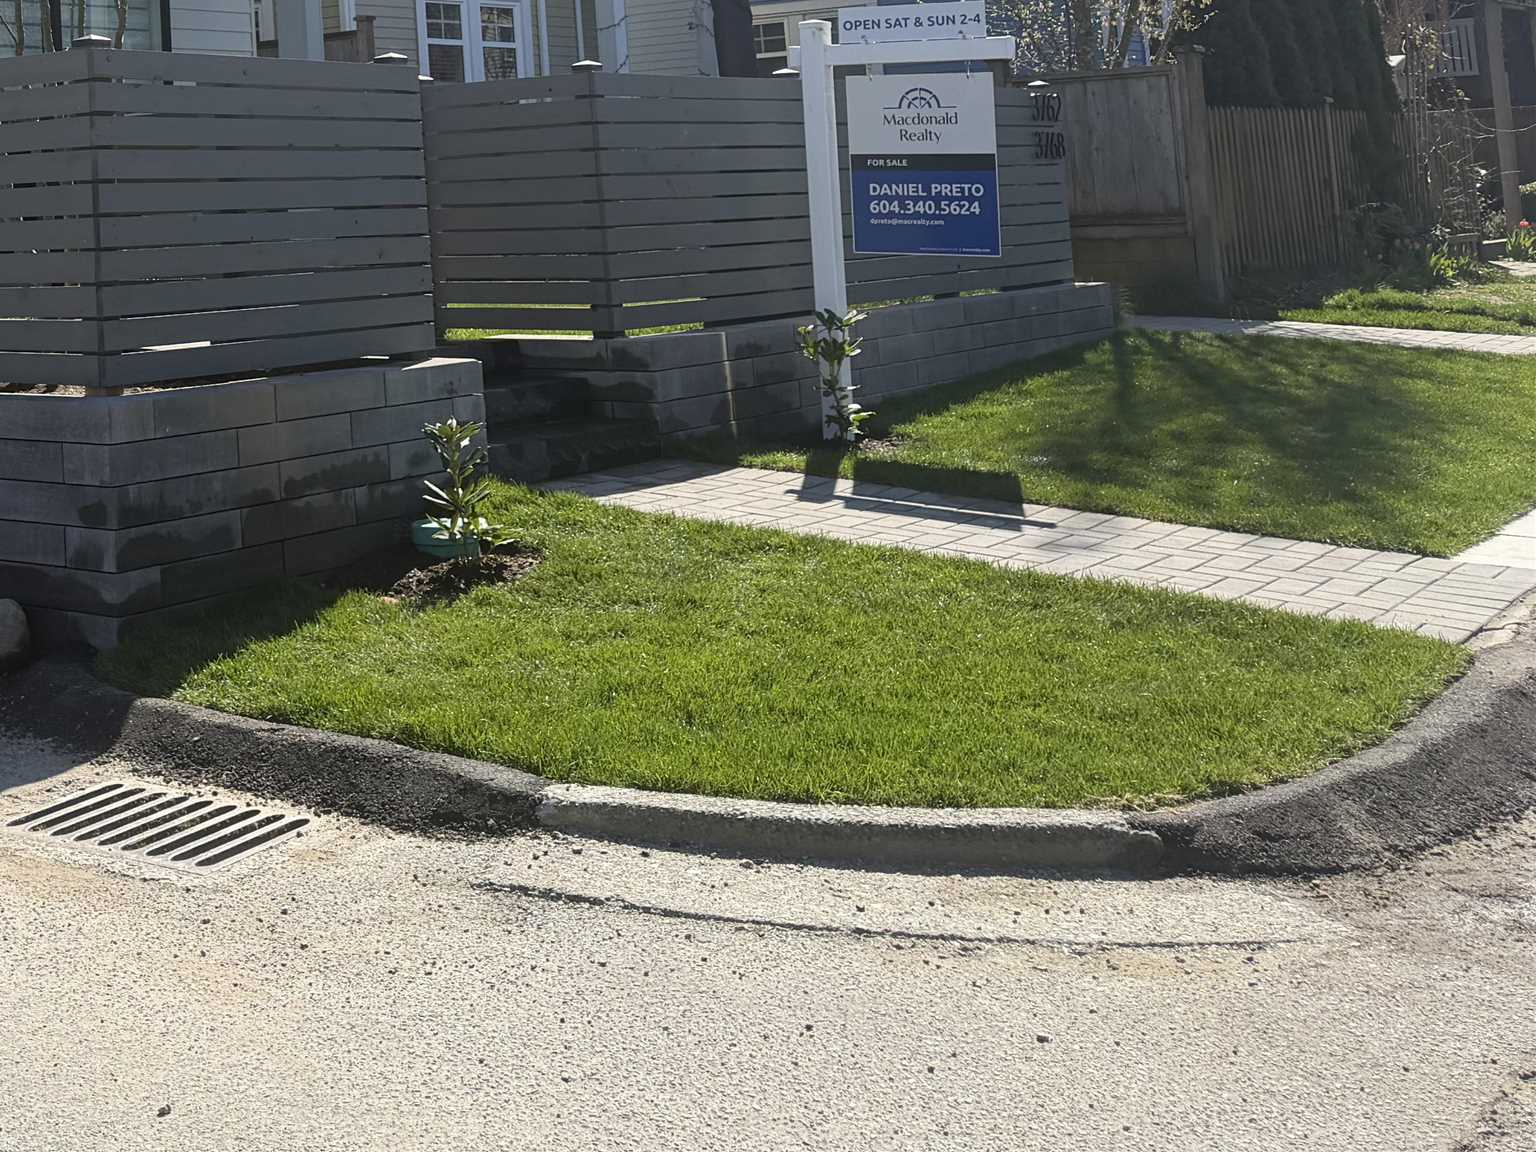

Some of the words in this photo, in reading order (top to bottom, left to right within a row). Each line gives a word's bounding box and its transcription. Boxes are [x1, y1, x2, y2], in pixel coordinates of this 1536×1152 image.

[843, 18, 881, 31] OPEN
[884, 17, 910, 29] SAT
[913, 16, 924, 28] &
[927, 14, 956, 27] SUN
[959, 13, 981, 25] 2-4
[883, 112, 958, 126] Macdonald
[899, 128, 942, 144] Realty
[867, 159, 885, 167] FOR
[886, 159, 908, 167] SALE
[869, 183, 927, 196] DANIEL
[931, 183, 984, 197] PRETO
[869, 200, 981, 215] 604.340.5624
